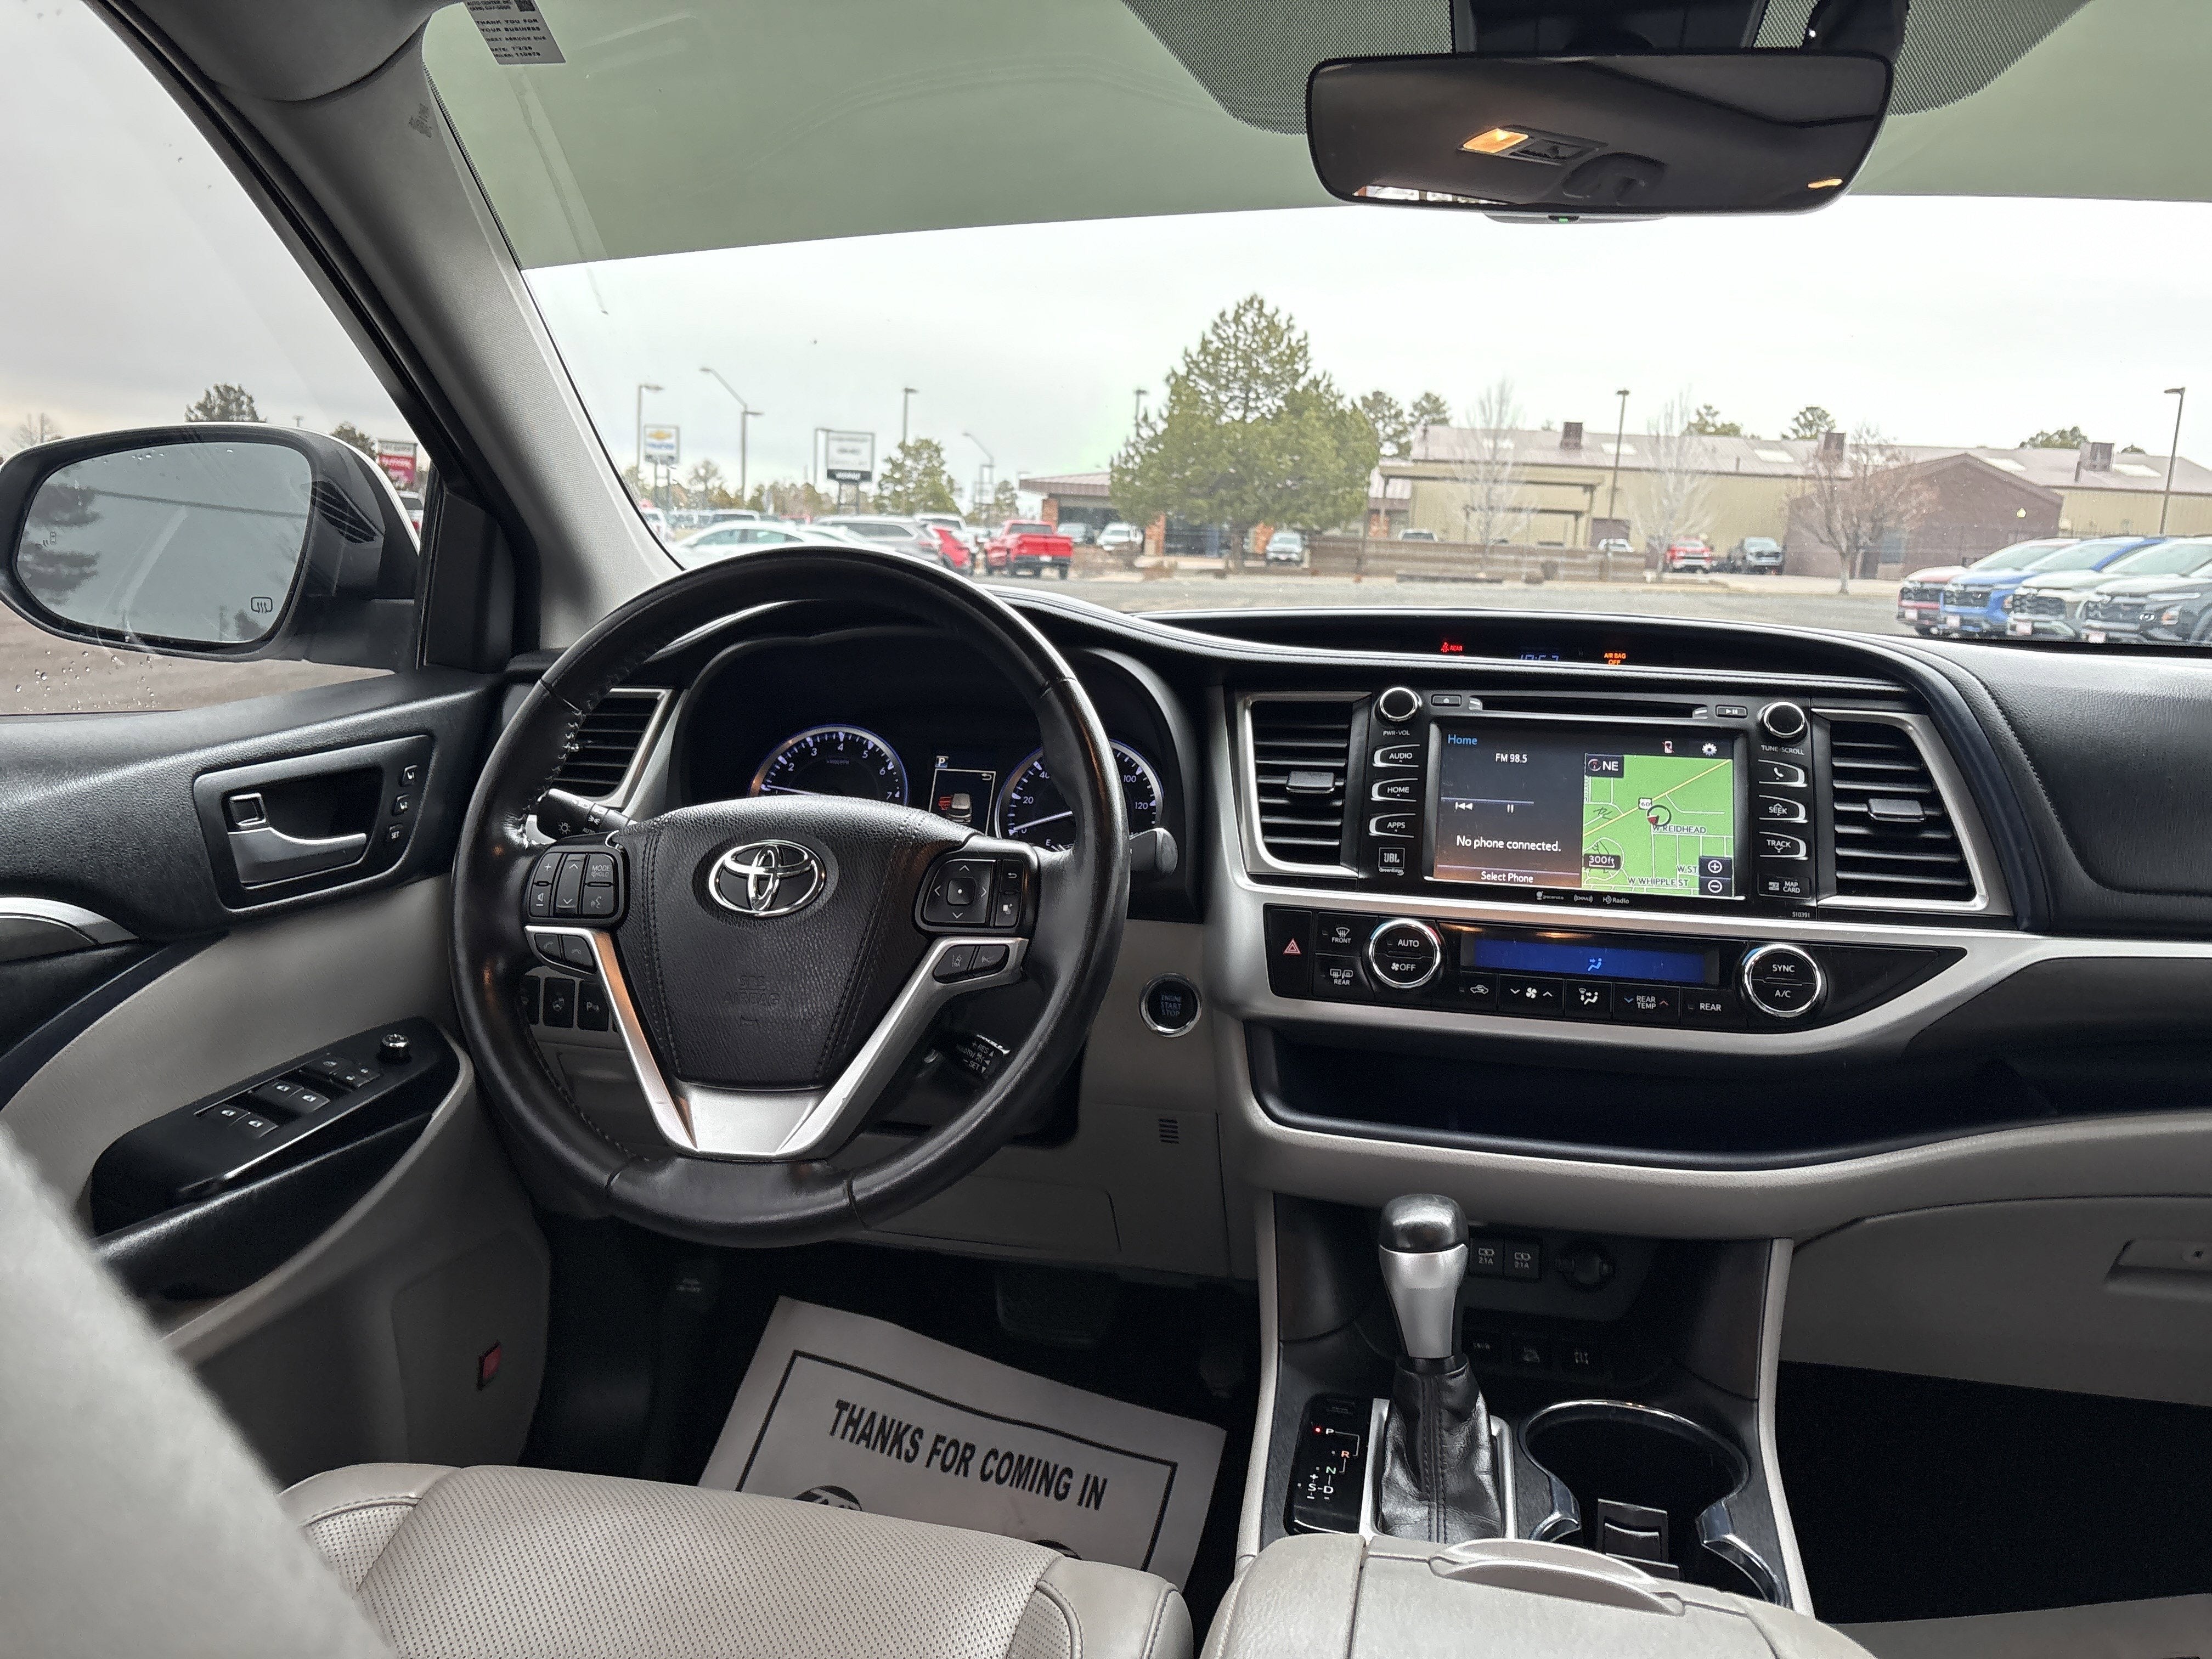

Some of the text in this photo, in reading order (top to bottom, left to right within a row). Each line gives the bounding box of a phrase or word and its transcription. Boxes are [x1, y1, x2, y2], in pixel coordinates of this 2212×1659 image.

[1447, 734, 1478, 746] Home
[811, 747, 817, 757] 3
[837, 743, 844, 752] 4
[862, 750, 868, 759] 5
[1495, 753, 1527, 764] FM 98.5
[938, 757, 946, 766] P
[1602, 760, 1619, 771] NE
[788, 763, 794, 771] 2
[879, 767, 886, 776] 6
[1123, 775, 1137, 783] 100
[886, 792, 893, 800] 7
[1023, 796, 1034, 804] 20
[1135, 802, 1148, 810] 120
[1768, 805, 1787, 814] SEEK
[1662, 825, 1706, 833] REIDHEAD
[1457, 836, 1561, 852] No phone connected.
[1767, 839, 1791, 848] TRACK
[1384, 853, 1400, 863] JBL
[1589, 855, 1615, 865] 300ft
[1481, 871, 1534, 883] Select Phone
[1638, 878, 1678, 886] WHIPPLE
[1397, 939, 1419, 947] AUTO
[1400, 963, 1417, 972] OFF
[1771, 963, 1796, 973] SYNC
[1333, 978, 1350, 986] REAR
[1775, 989, 1791, 998] A/C
[1636, 995, 1656, 1003] REAR
[1160, 1001, 1181, 1010] START
[1637, 1001, 1656, 1011] TEMP
[1700, 1002, 1722, 1012] REAR
[968, 1060, 980, 1070] SET
[828, 1399, 1108, 1511] THANKS FOR COMING IN
[1340, 1450, 1350, 1458] R
[1325, 1466, 1336, 1475] N
[1307, 1483, 1334, 1494] S D
